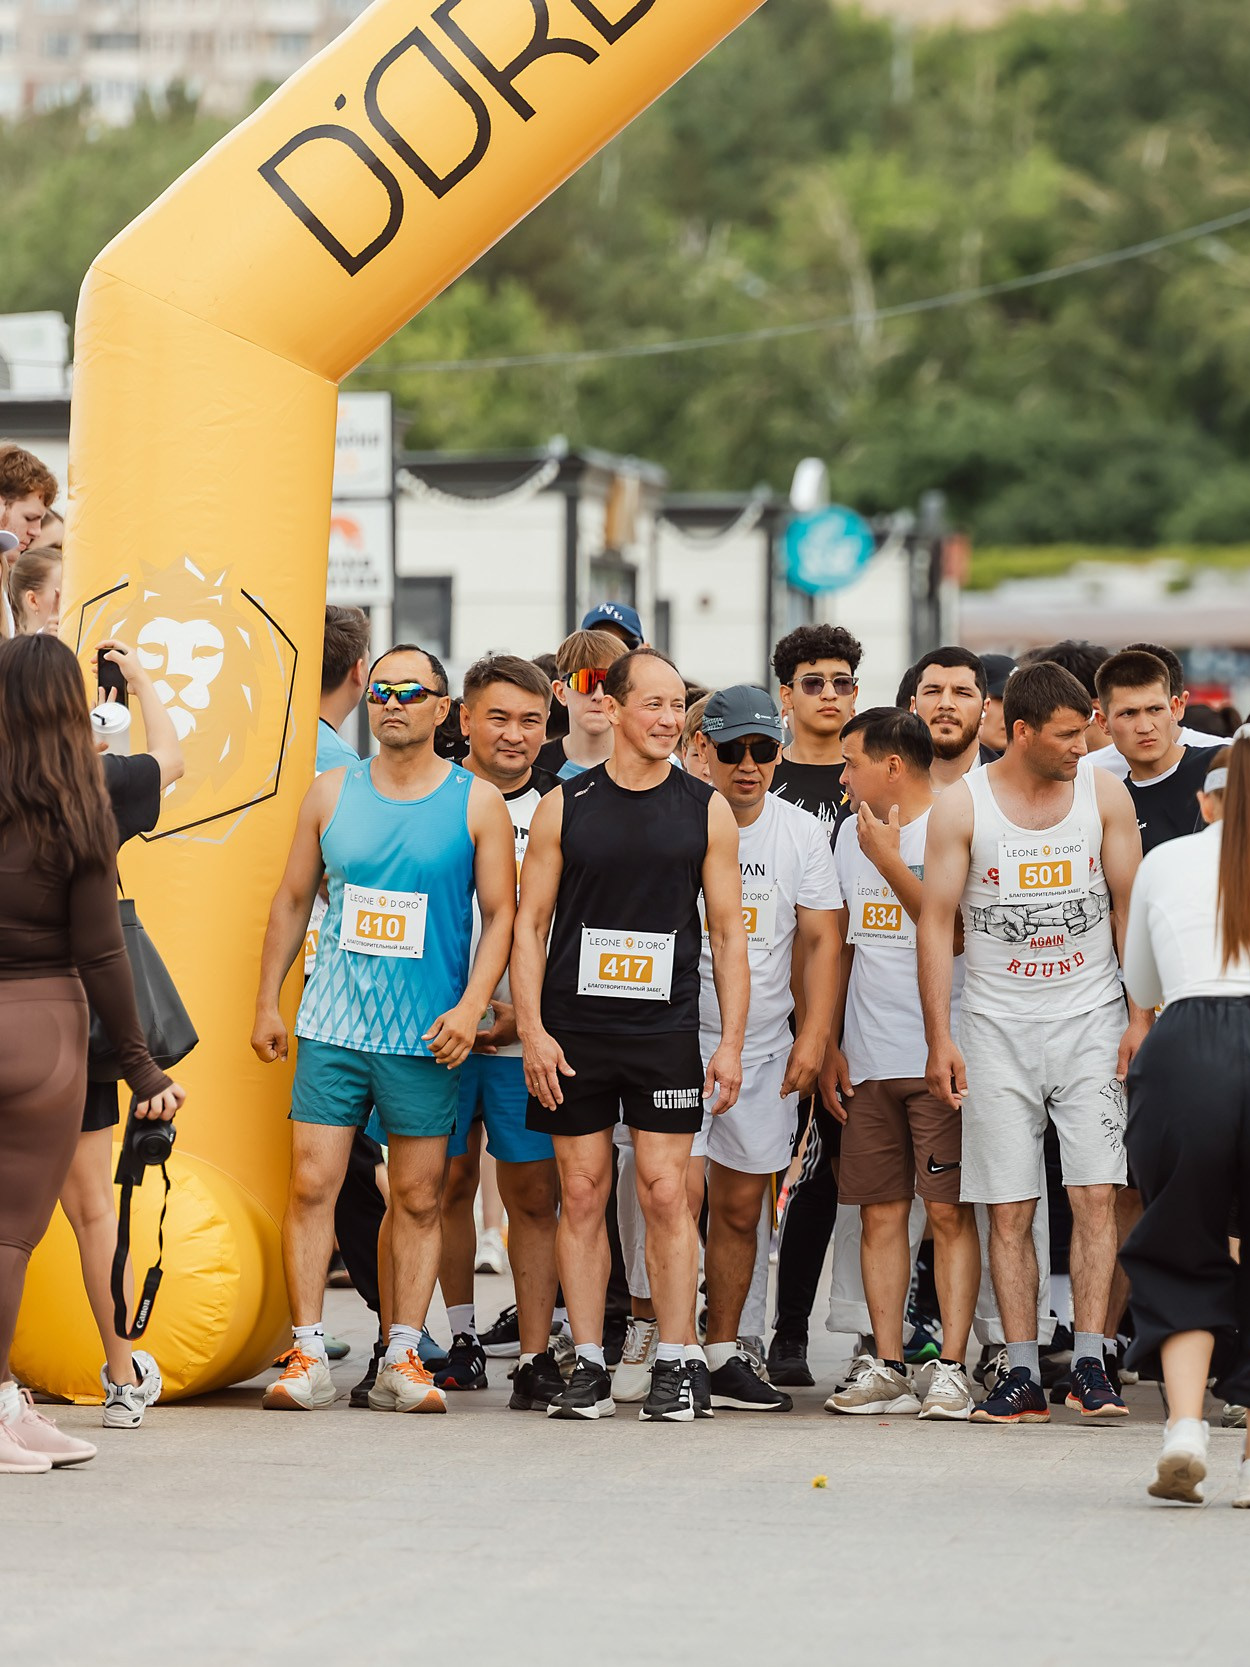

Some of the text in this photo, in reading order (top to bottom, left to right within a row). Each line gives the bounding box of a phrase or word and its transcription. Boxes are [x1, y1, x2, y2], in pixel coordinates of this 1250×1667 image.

[1006, 844, 1082, 858] LEONE D'ORO
[1024, 864, 1064, 886] 501
[349, 893, 375, 906] LEONE
[857, 887, 880, 897] LEONE
[359, 914, 400, 938] 410
[866, 906, 897, 927] 334
[589, 937, 666, 951] LEONE D'ORO
[1030, 934, 1064, 948] AGAIN
[603, 956, 648, 979] 417
[1006, 951, 1085, 978] ROUND
[136, 1299, 151, 1329] Canon
